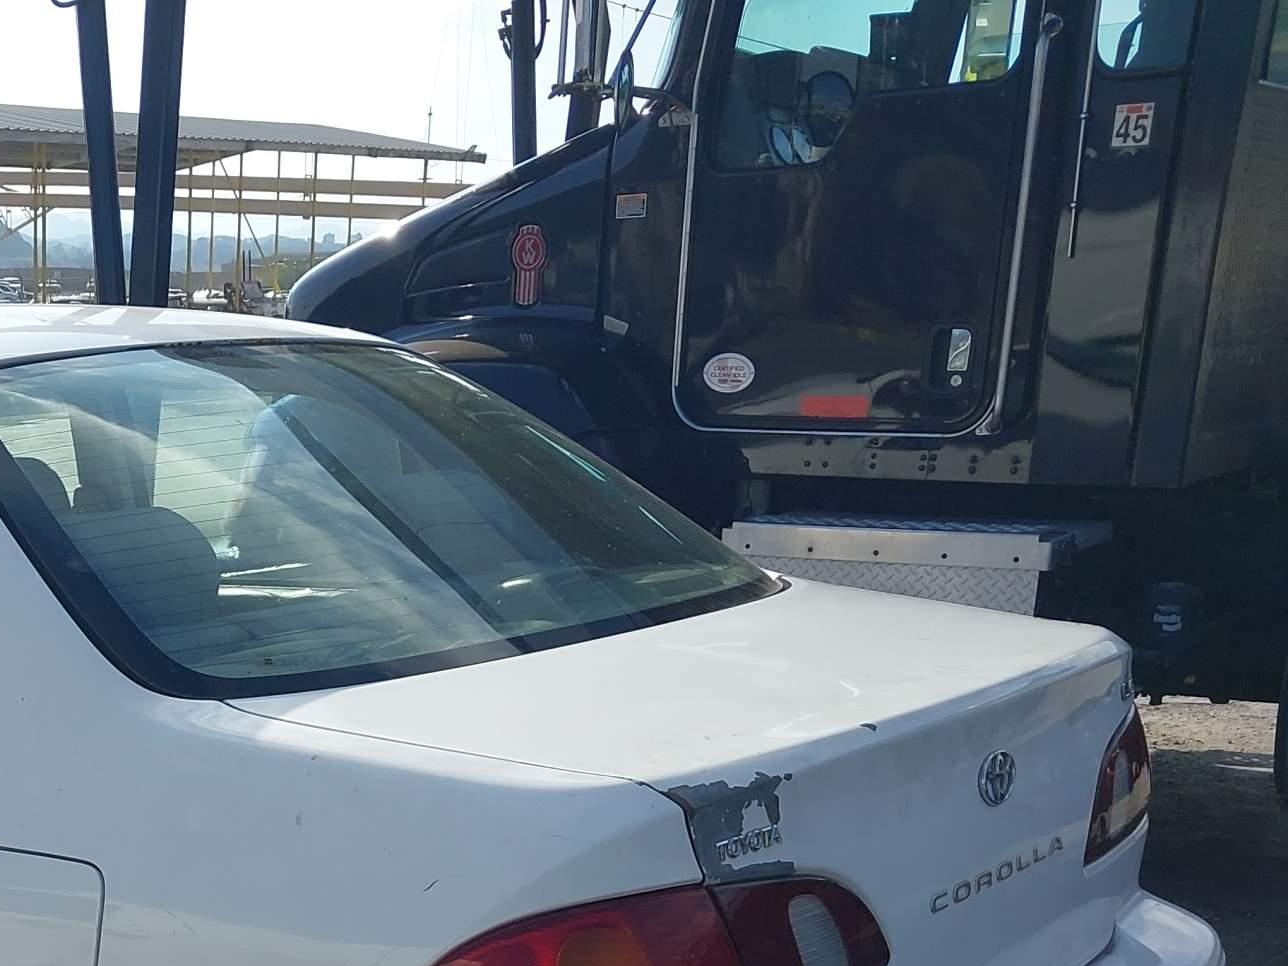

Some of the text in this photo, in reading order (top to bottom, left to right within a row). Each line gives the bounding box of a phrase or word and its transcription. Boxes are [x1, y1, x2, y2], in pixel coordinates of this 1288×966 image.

[1115, 114, 1149, 144] 45
[715, 825, 782, 862] TOYOTA
[929, 836, 1064, 914] COROLLA
